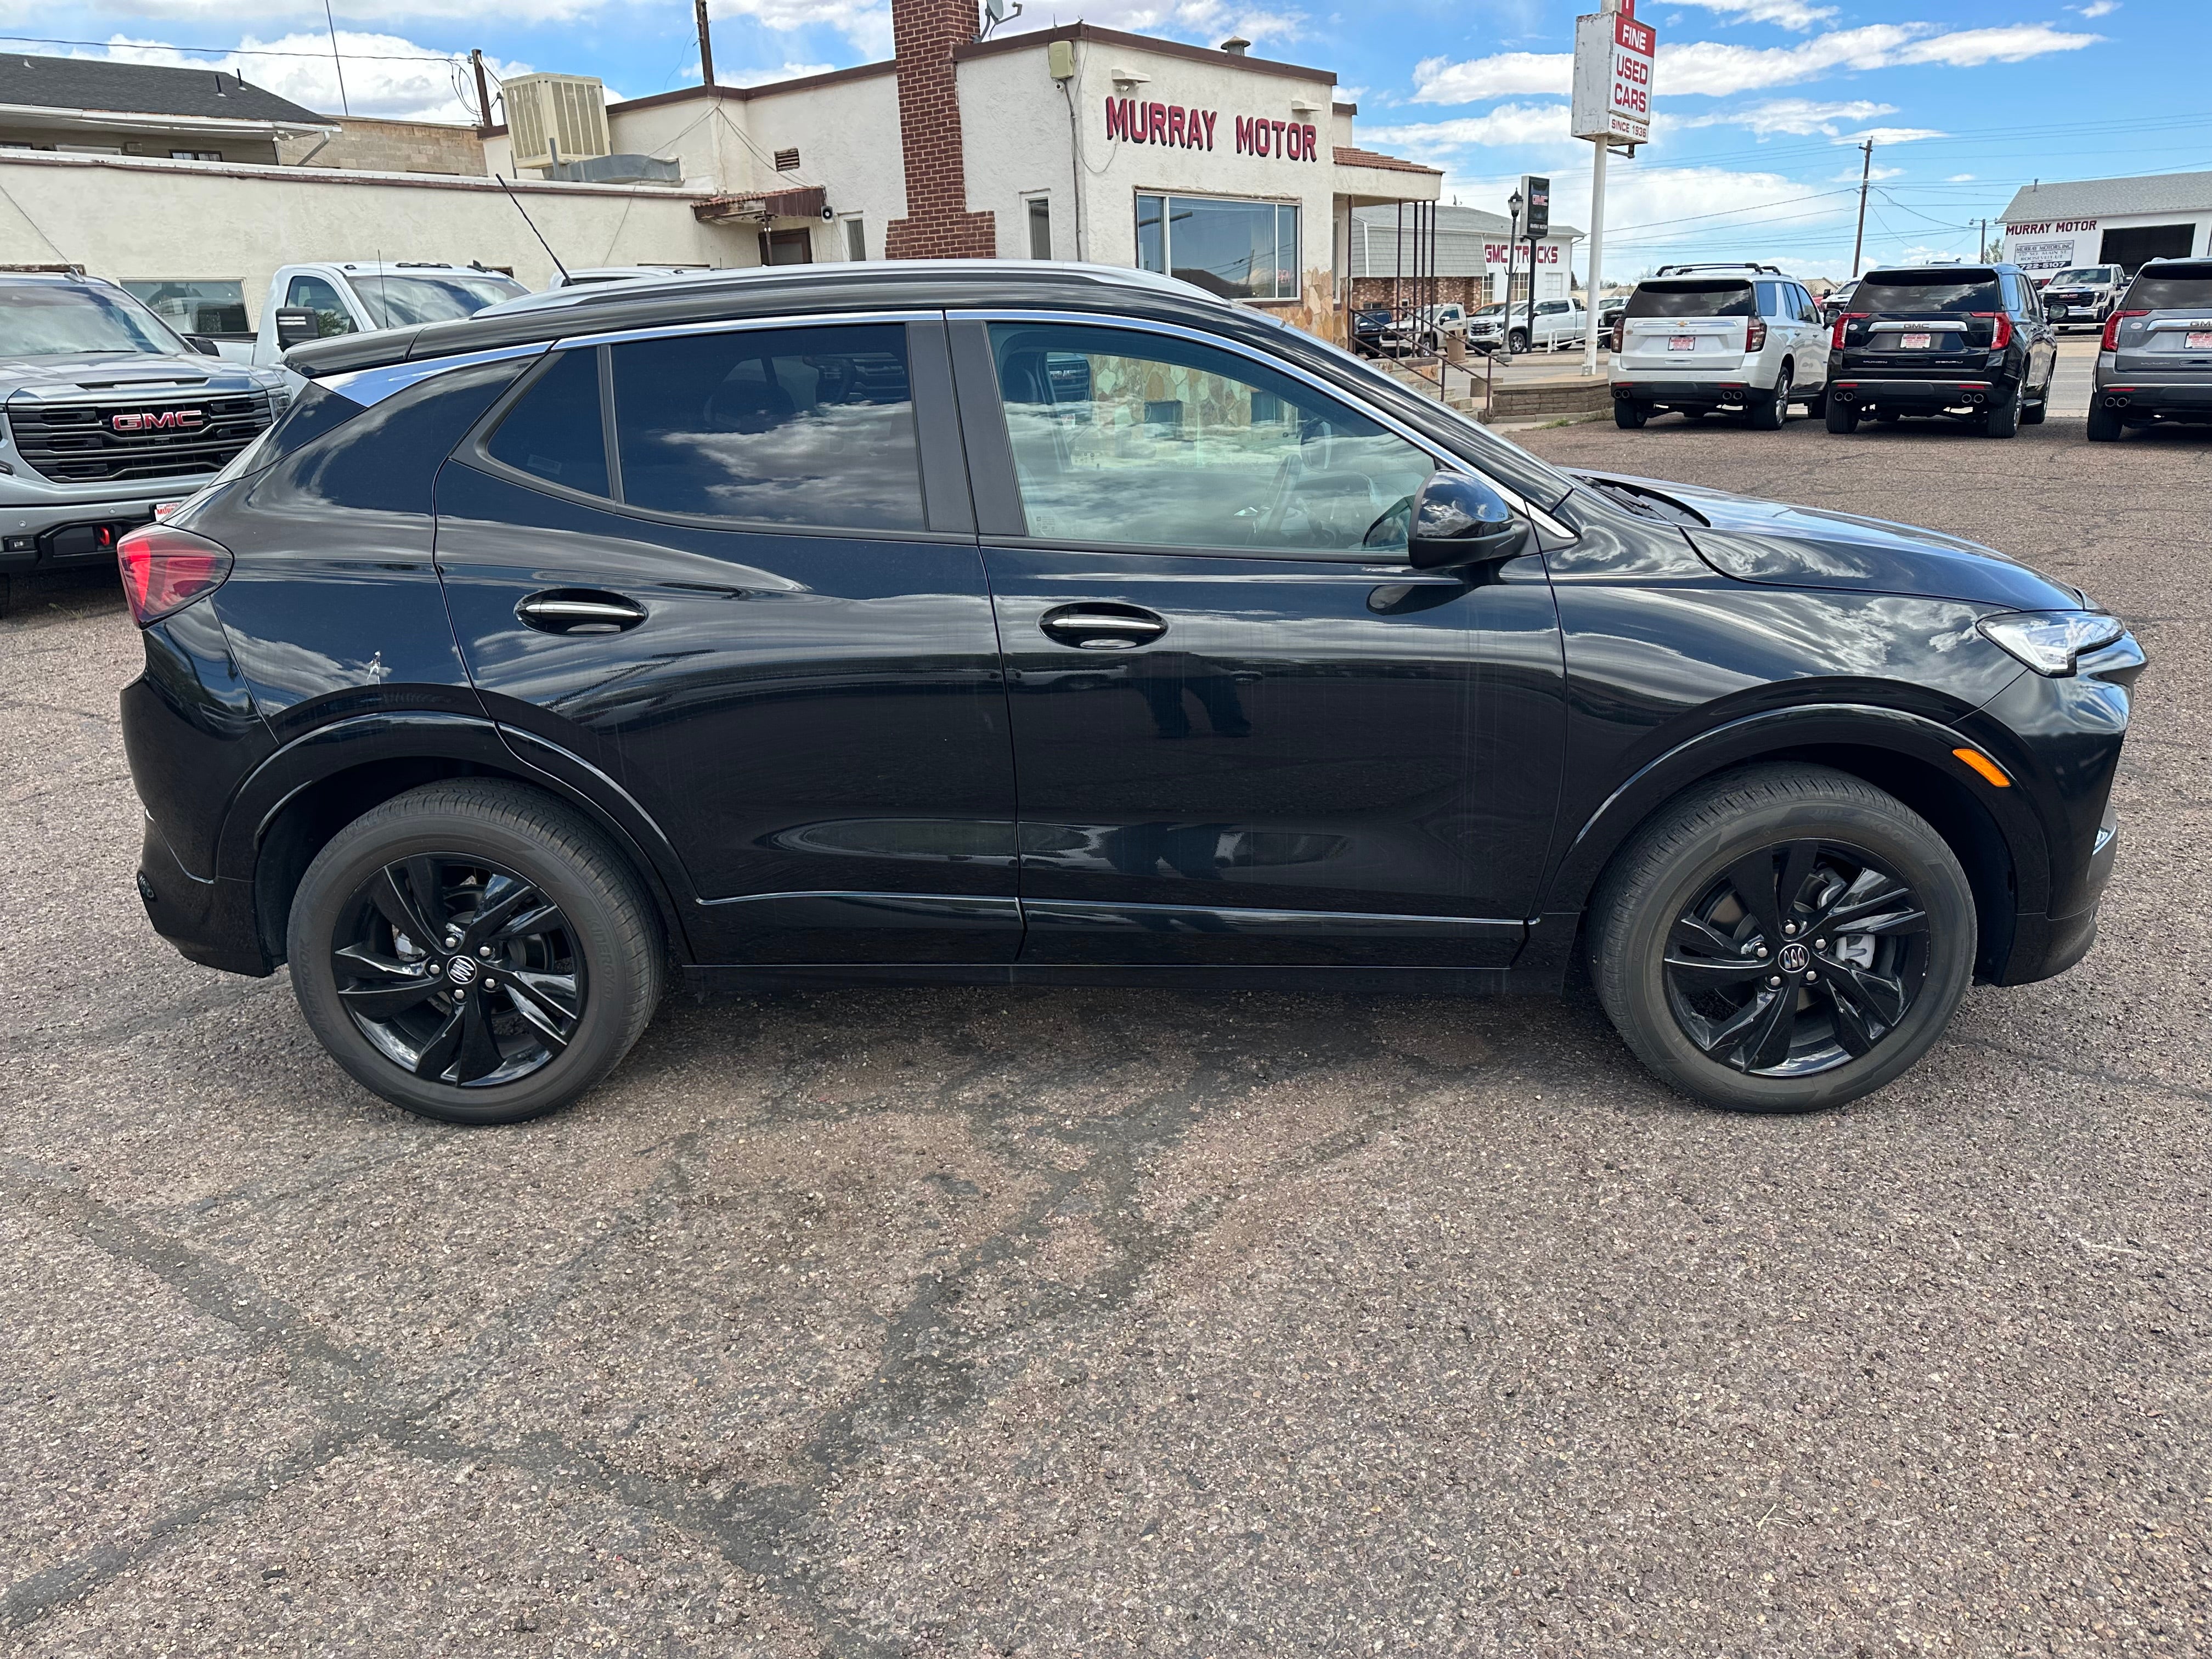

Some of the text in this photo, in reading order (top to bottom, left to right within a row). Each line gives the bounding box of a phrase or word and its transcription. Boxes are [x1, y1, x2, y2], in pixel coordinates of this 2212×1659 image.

[1622, 24, 1646, 51] FINE
[1616, 53, 1648, 85] USED
[1615, 82, 1646, 113] CARS
[1105, 96, 1317, 162] MURRAY MOTOR
[1611, 119, 1646, 138] SINCE 1936
[2006, 220, 2097, 236] MURRAY MOTOR
[1485, 244, 1559, 264] GMC TRCKS
[2019, 262, 2066, 270] 722-5107
[112, 410, 204, 431] GMC
